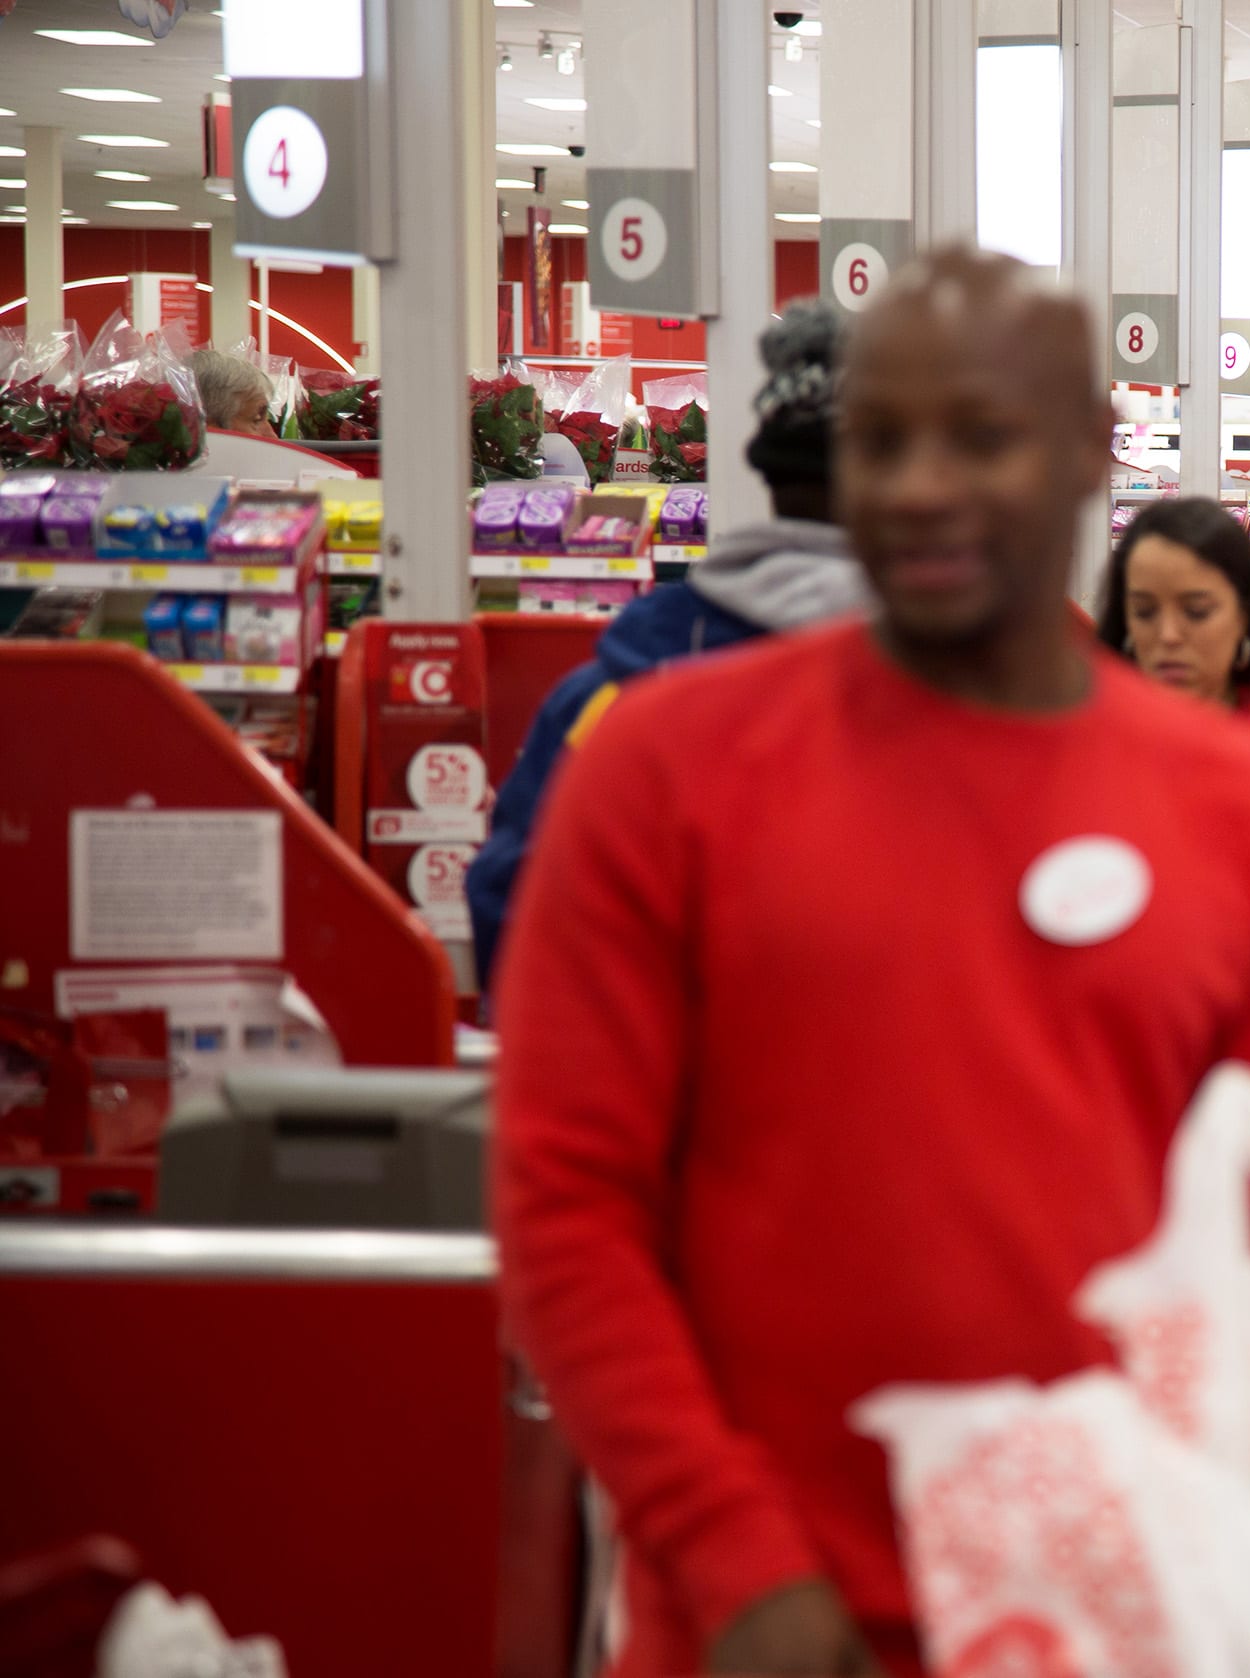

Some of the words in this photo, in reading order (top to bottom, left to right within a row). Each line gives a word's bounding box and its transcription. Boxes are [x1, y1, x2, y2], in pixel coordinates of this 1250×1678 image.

[268, 138, 290, 189] 4
[620, 216, 644, 261] 5
[848, 257, 869, 296] 6
[1128, 325, 1144, 353] 8
[1224, 345, 1237, 369] 9
